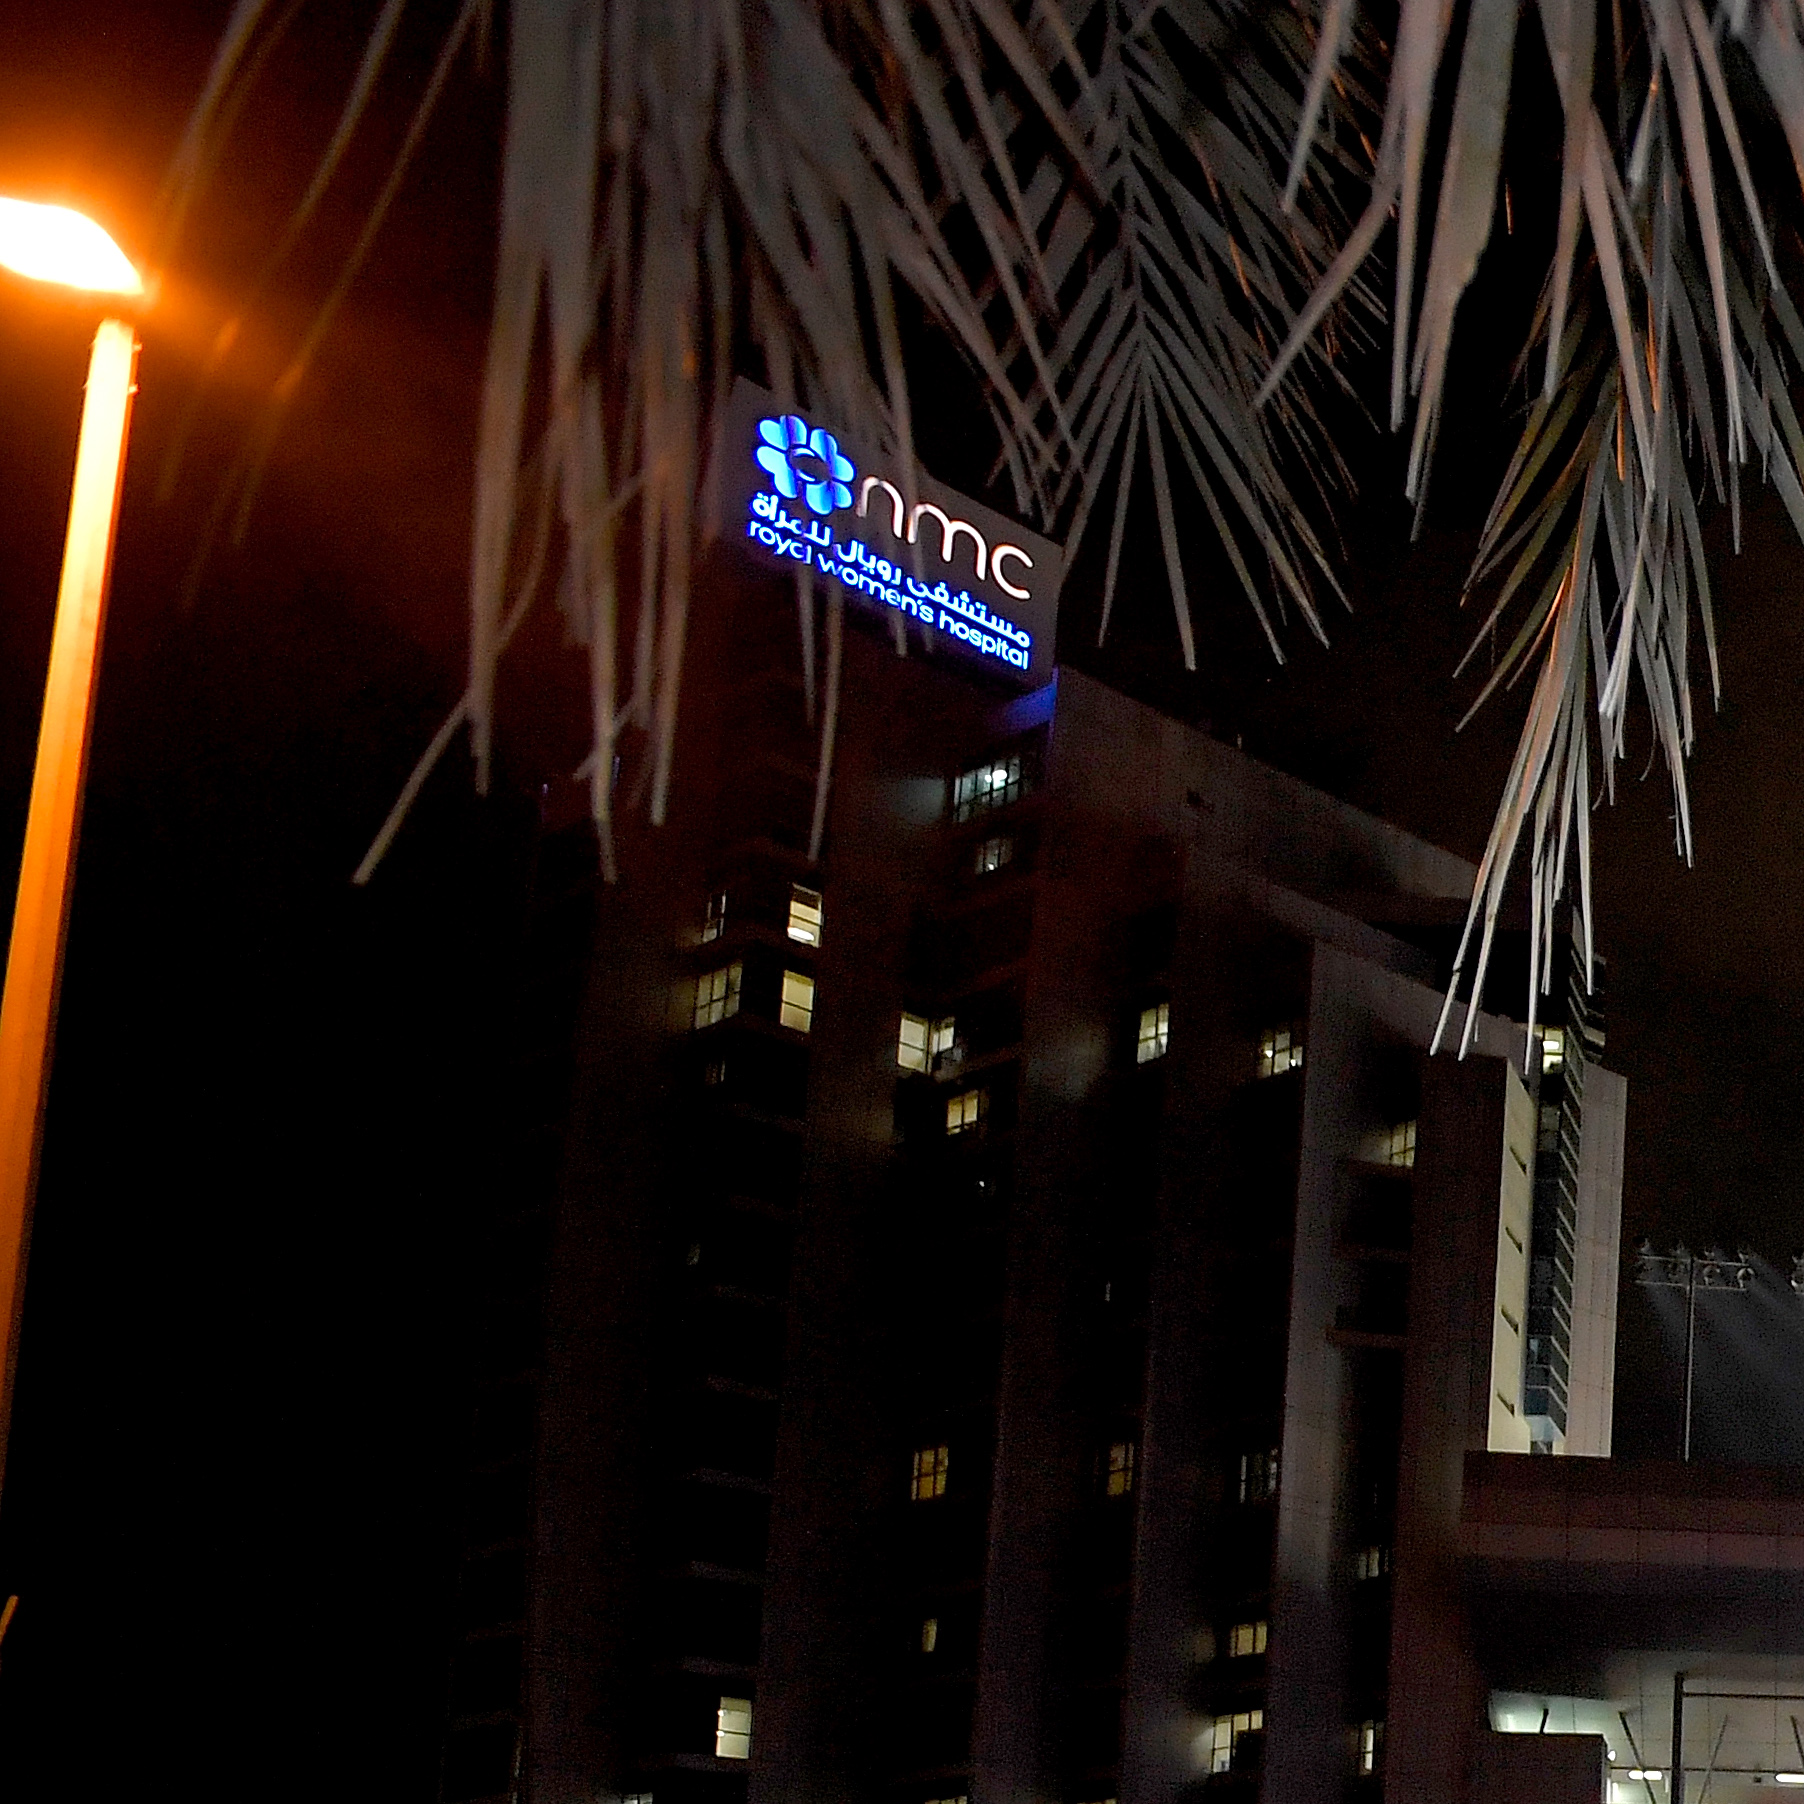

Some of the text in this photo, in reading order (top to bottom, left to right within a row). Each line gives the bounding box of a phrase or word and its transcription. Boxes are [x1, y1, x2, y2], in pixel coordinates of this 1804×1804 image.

[857, 475, 1034, 600] nmc
[817, 553, 934, 624] women's
[939, 609, 1029, 670] hospital
